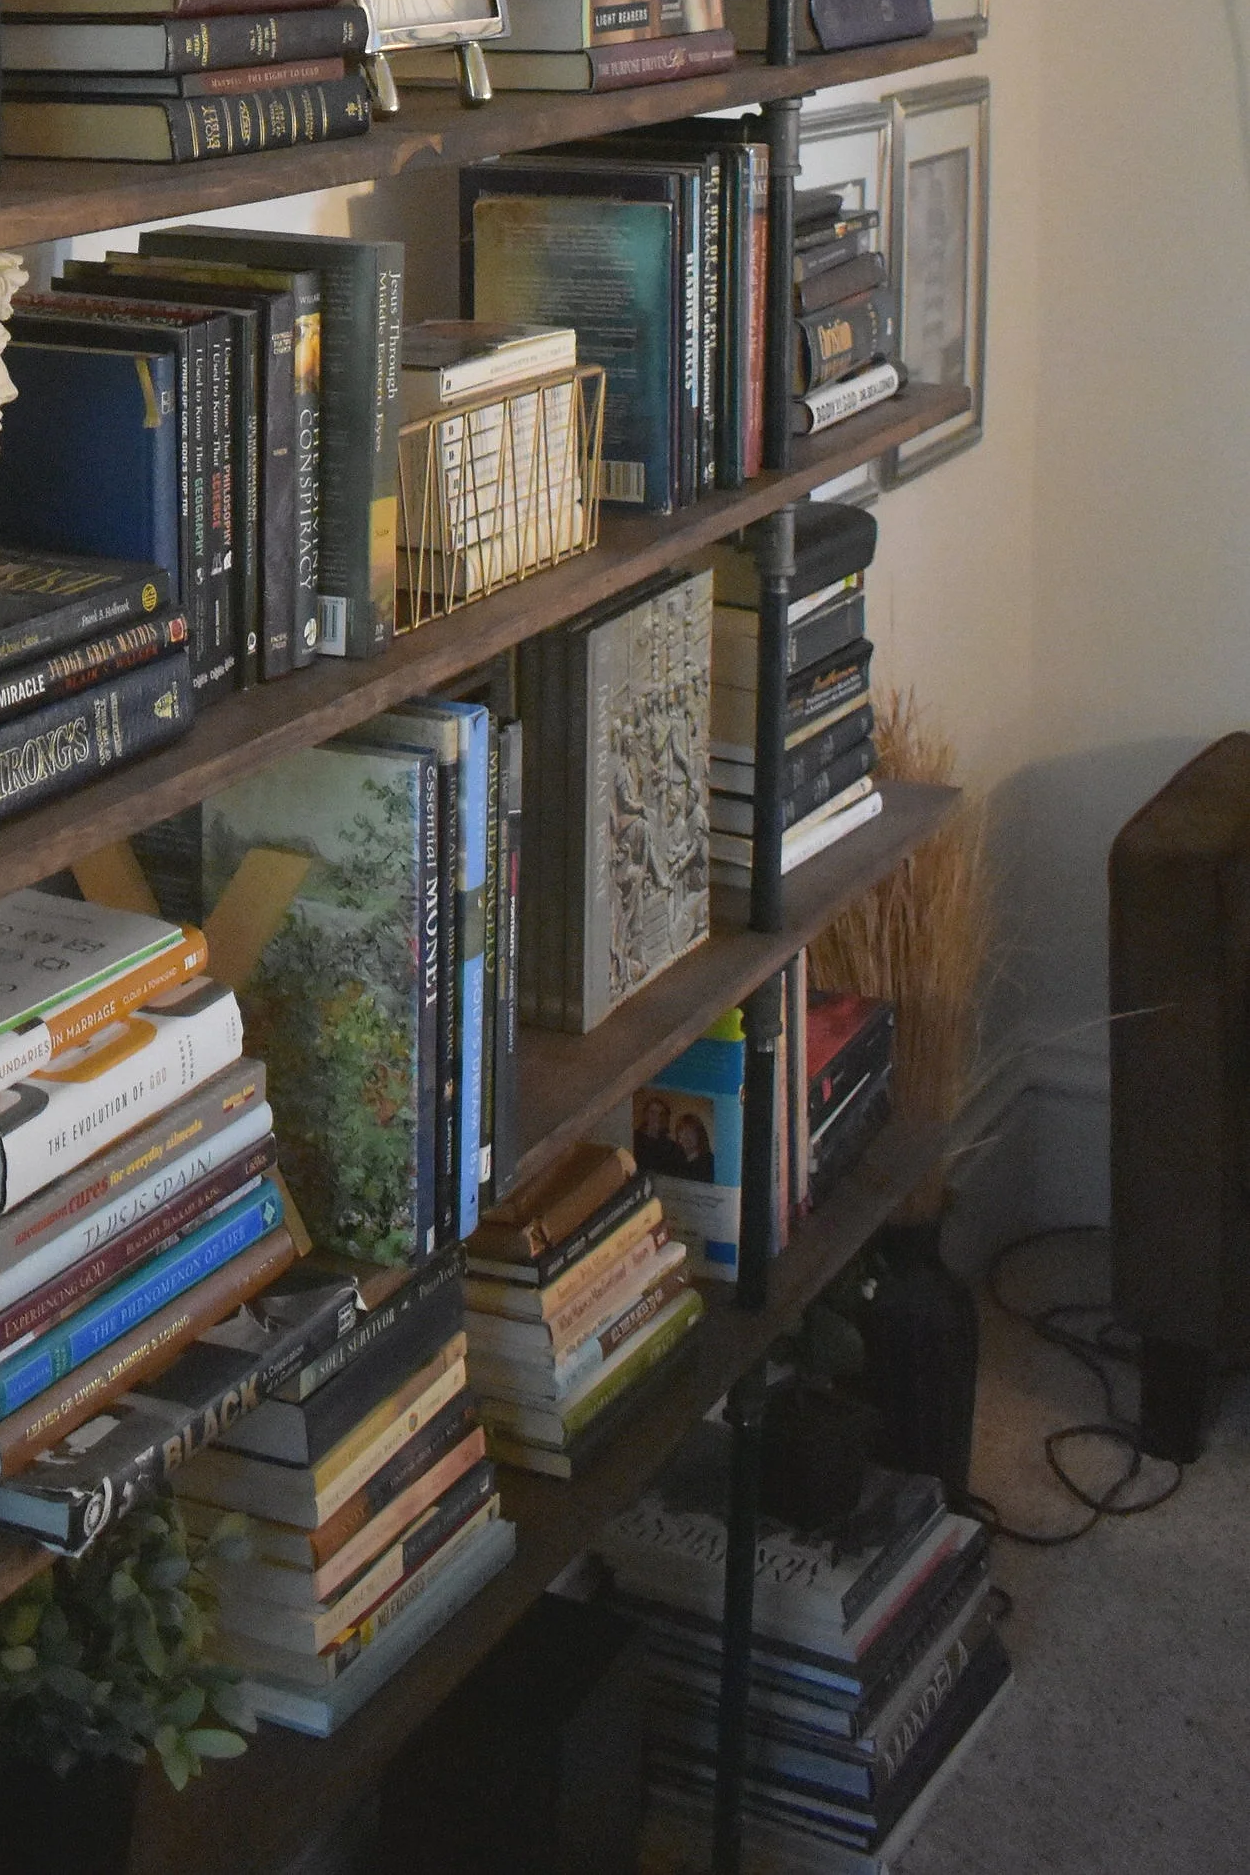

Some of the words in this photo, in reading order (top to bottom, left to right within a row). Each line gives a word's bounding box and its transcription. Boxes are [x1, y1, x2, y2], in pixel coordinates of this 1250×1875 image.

[595, 13, 616, 28] LIGHT
[617, 9, 648, 24] BEARERS
[377, 271, 387, 335] Middle
[388, 270, 402, 315] Jesus
[212, 352, 221, 383] Used
[376, 342, 386, 406] Eastern
[386, 319, 400, 400] Through
[212, 400, 221, 434] Know
[375, 412, 385, 453] Eyes
[212, 440, 221, 467] That
[211, 472, 222, 529] SCIENCE
[299, 408, 313, 590] CONSPIRACY
[425, 764, 438, 868] Essential
[484, 749, 499, 974] MICHELANGELO
[424, 875, 438, 1008] MONET
[48, 1131, 68, 1157] THE
[72, 1090, 129, 1142] EVOLUTION
[132, 1081, 145, 1103] OF
[149, 1066, 169, 1091] GOD
[3, 1283, 80, 1340] EXPERIENCING
[80, 1259, 107, 1290] GOD
[90, 1315, 118, 1345] THE
[119, 1256, 201, 1325] PHENOMENON
[202, 1244, 221, 1263] OF
[219, 1222, 247, 1255] LIFE
[318, 1345, 348, 1375] SOUL
[347, 1308, 396, 1354] SURVIVOR
[161, 1372, 260, 1473] BLACK
